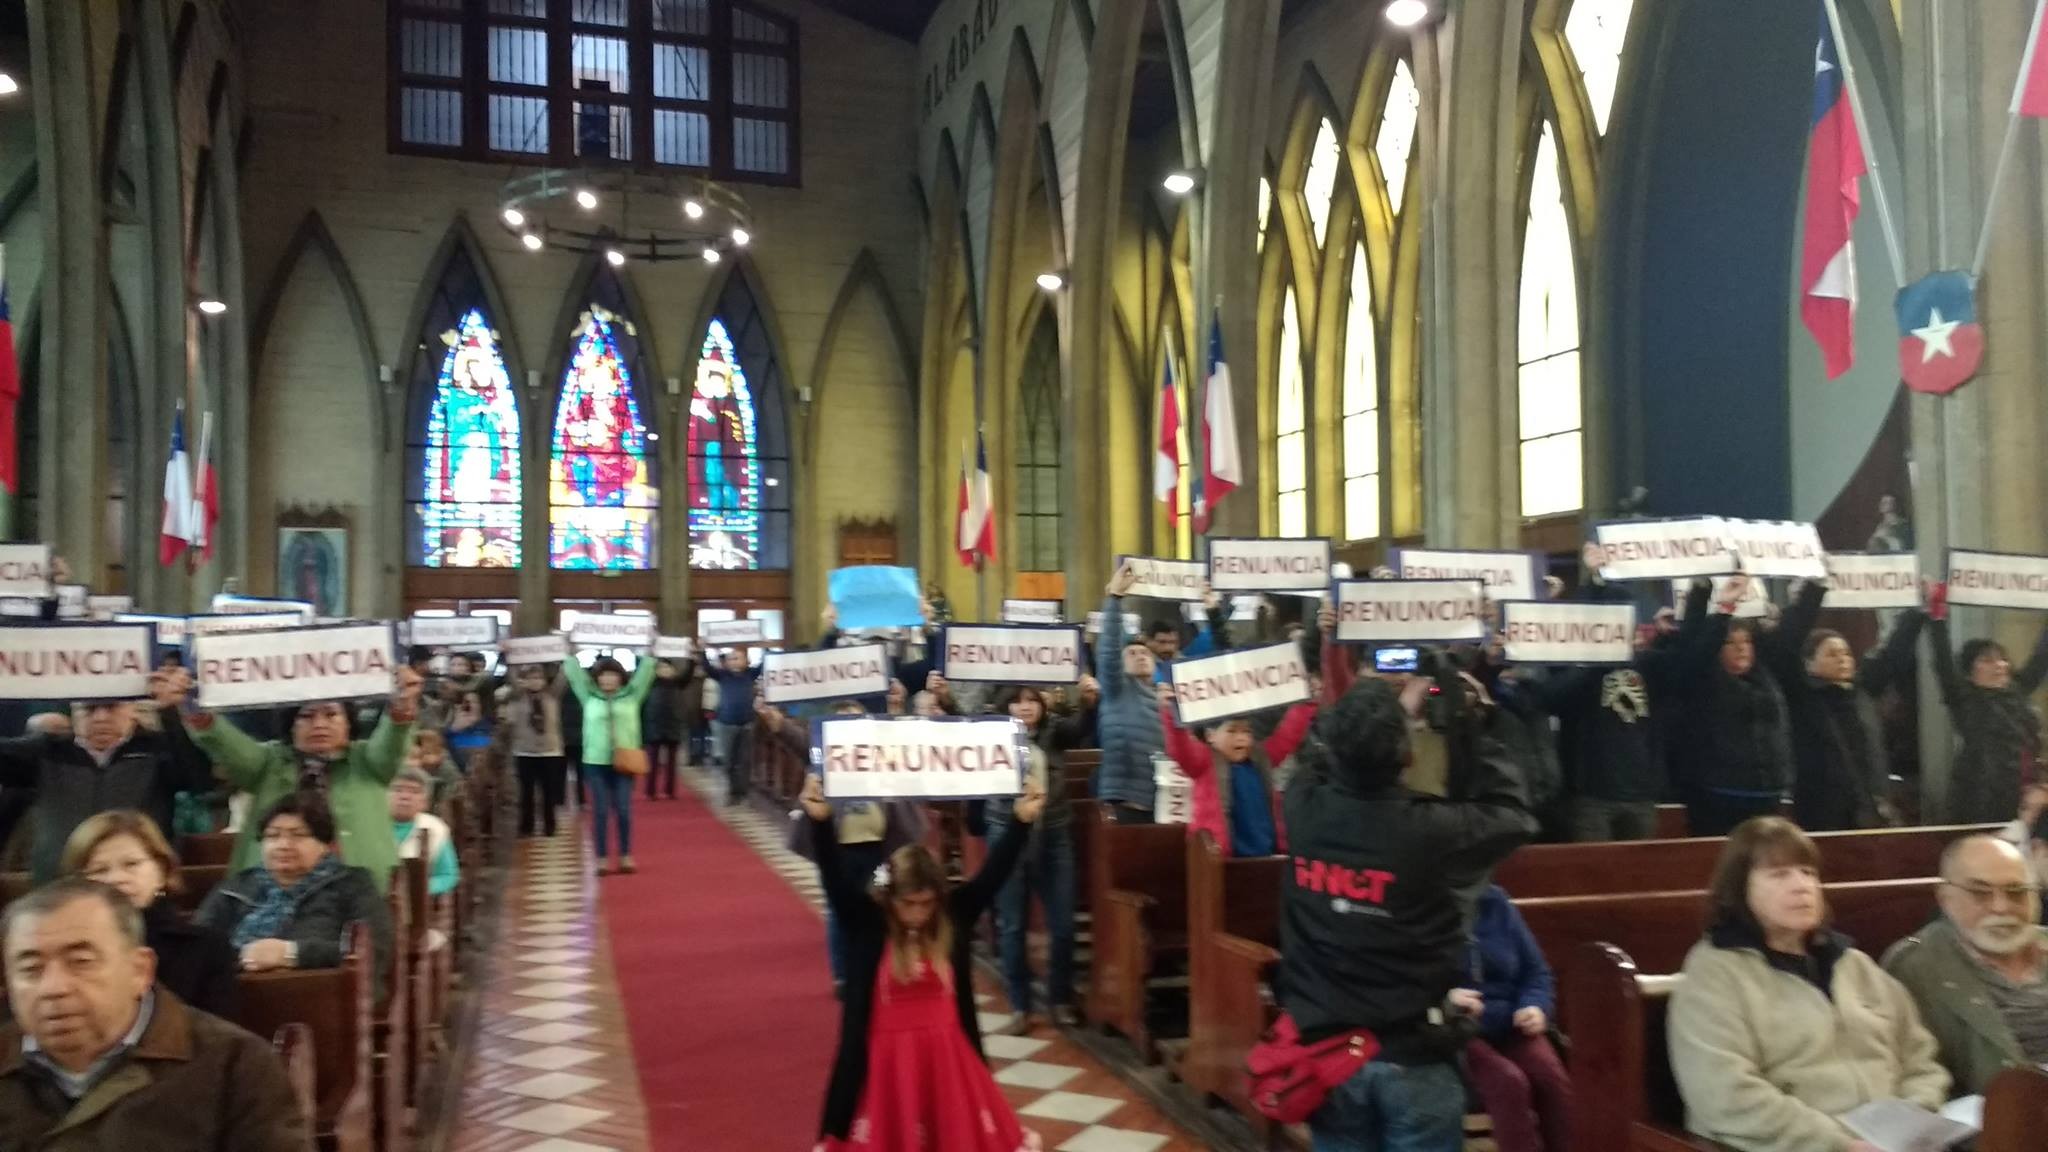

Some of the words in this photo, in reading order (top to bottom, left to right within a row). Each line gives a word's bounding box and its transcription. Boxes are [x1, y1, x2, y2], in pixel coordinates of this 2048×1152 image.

[1604, 538, 1726, 561] RENUNCIA
[1215, 556, 1323, 574] RENUNCIA
[1342, 602, 1475, 623] RENUNCIA
[1508, 622, 1625, 643] RENUNCIA
[0, 649, 142, 677] NUNCIA
[202, 648, 386, 684] RENUNCIA
[949, 644, 1075, 666] RENUNCIA
[767, 660, 881, 686] RENUNCIA
[1175, 660, 1304, 703] RENUNCIA
[828, 744, 1013, 772] RENUNCIA
